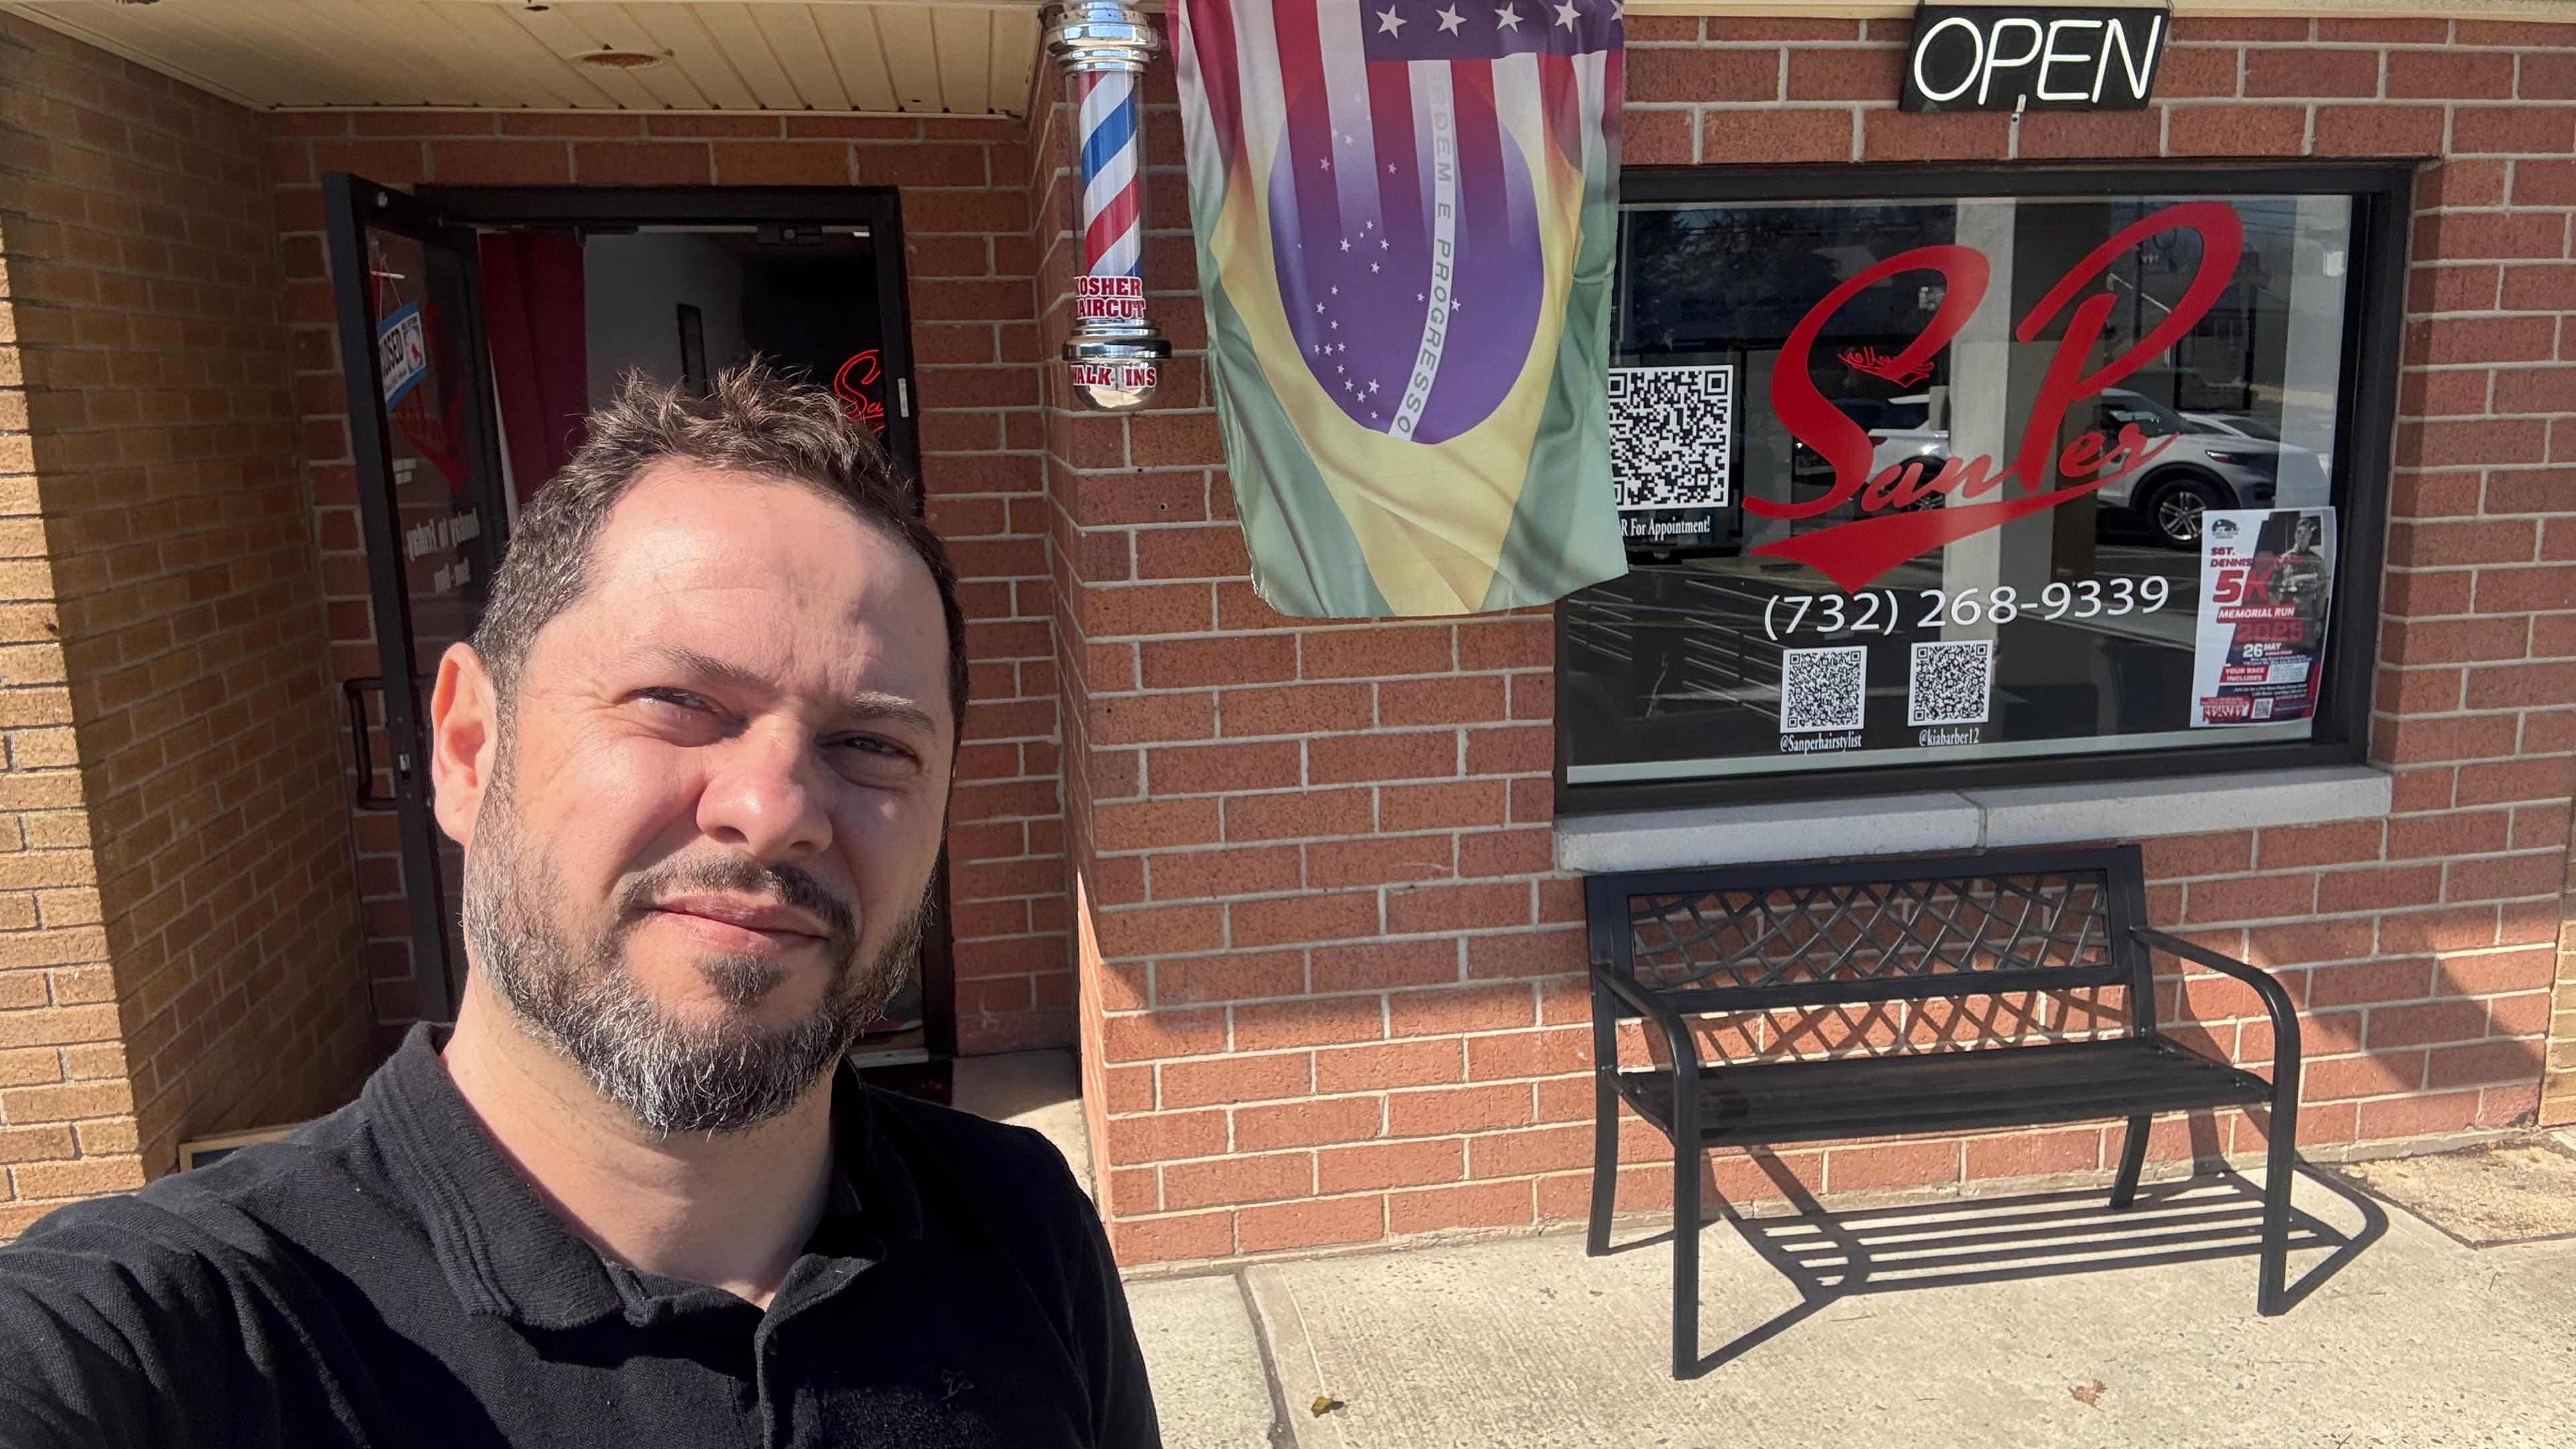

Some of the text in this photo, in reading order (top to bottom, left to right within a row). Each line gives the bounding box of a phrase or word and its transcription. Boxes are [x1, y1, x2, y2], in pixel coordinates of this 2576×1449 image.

[1914, 15, 2161, 105] OPEN
[1397, 71, 1452, 434] RDEM E PROGRESSO
[1077, 299, 1146, 318] AIRCUT
[1125, 368, 1156, 387] INS
[1621, 515, 1711, 541] R For Appointment!
[2210, 557, 2253, 568] DENNIS
[2212, 569, 2273, 603] 5K
[1764, 575, 2169, 641] (732) 268-9339
[2218, 606, 2295, 619] MEMORIAL RUN
[2243, 643, 2264, 658] 26
[2263, 643, 2282, 651] MAY
[1780, 731, 1862, 756] @Sanperhairstylist
[1919, 727, 1980, 747] @kiabarber12
